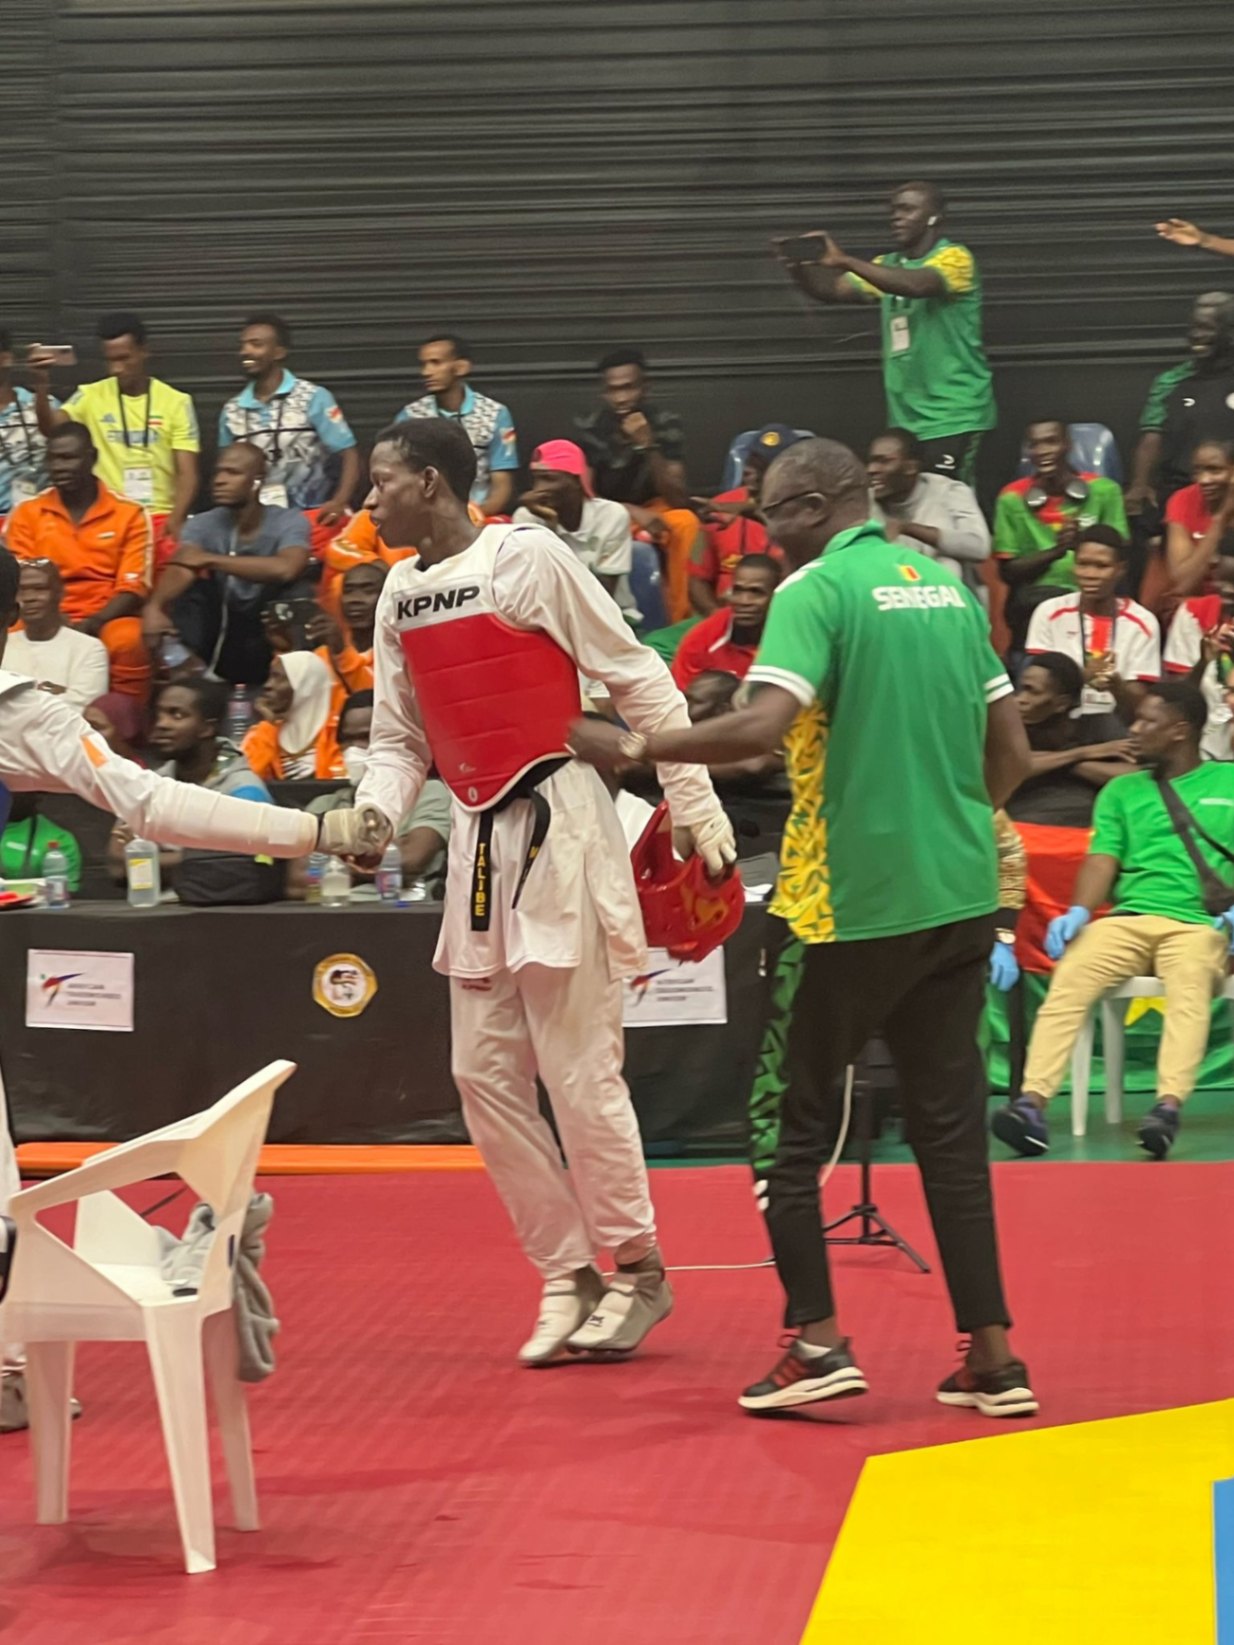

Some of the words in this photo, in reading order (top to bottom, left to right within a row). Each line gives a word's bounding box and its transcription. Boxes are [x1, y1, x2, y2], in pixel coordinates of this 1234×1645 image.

[397, 585, 480, 620] KPNP
[871, 585, 967, 611] SENEGAL
[474, 842, 487, 917] TALIBE
